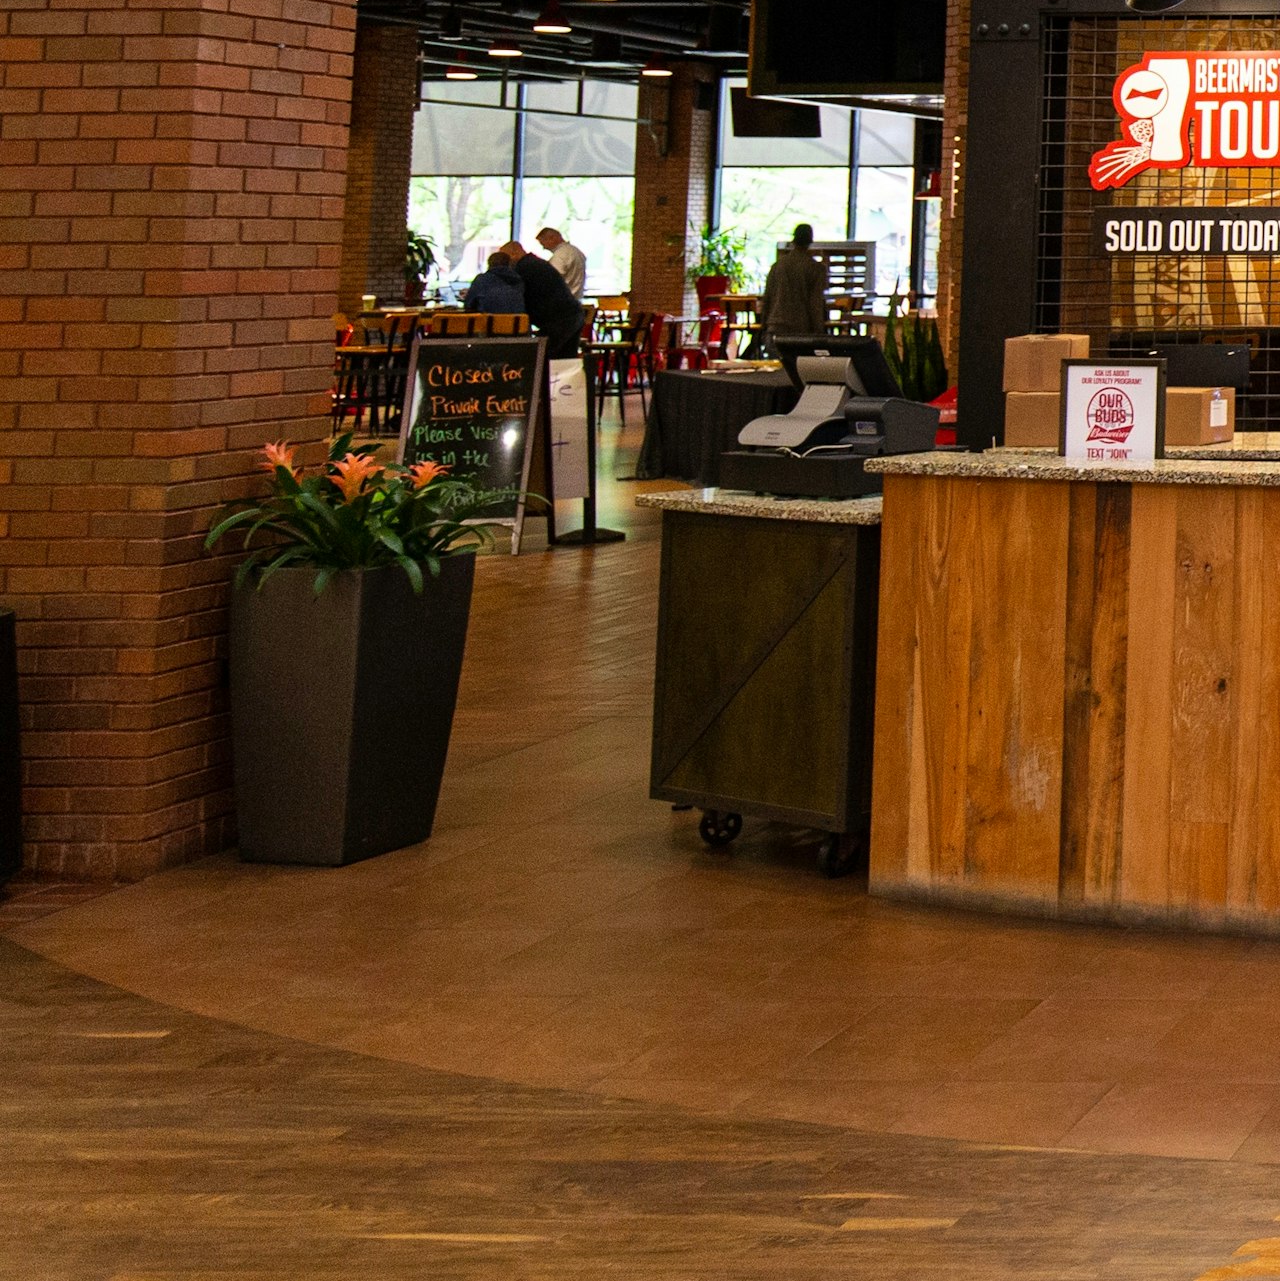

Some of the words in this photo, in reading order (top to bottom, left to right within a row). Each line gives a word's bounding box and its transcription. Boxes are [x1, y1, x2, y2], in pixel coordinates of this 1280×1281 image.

[1105, 220, 1162, 251] SOLD
[1169, 220, 1214, 251] OUT
[428, 365, 493, 387] Closed
[501, 363, 525, 382] for
[486, 395, 529, 413] Event
[1099, 393, 1123, 408] OUR
[1095, 409, 1127, 424] BUDS
[1087, 448, 1105, 459] TEXT
